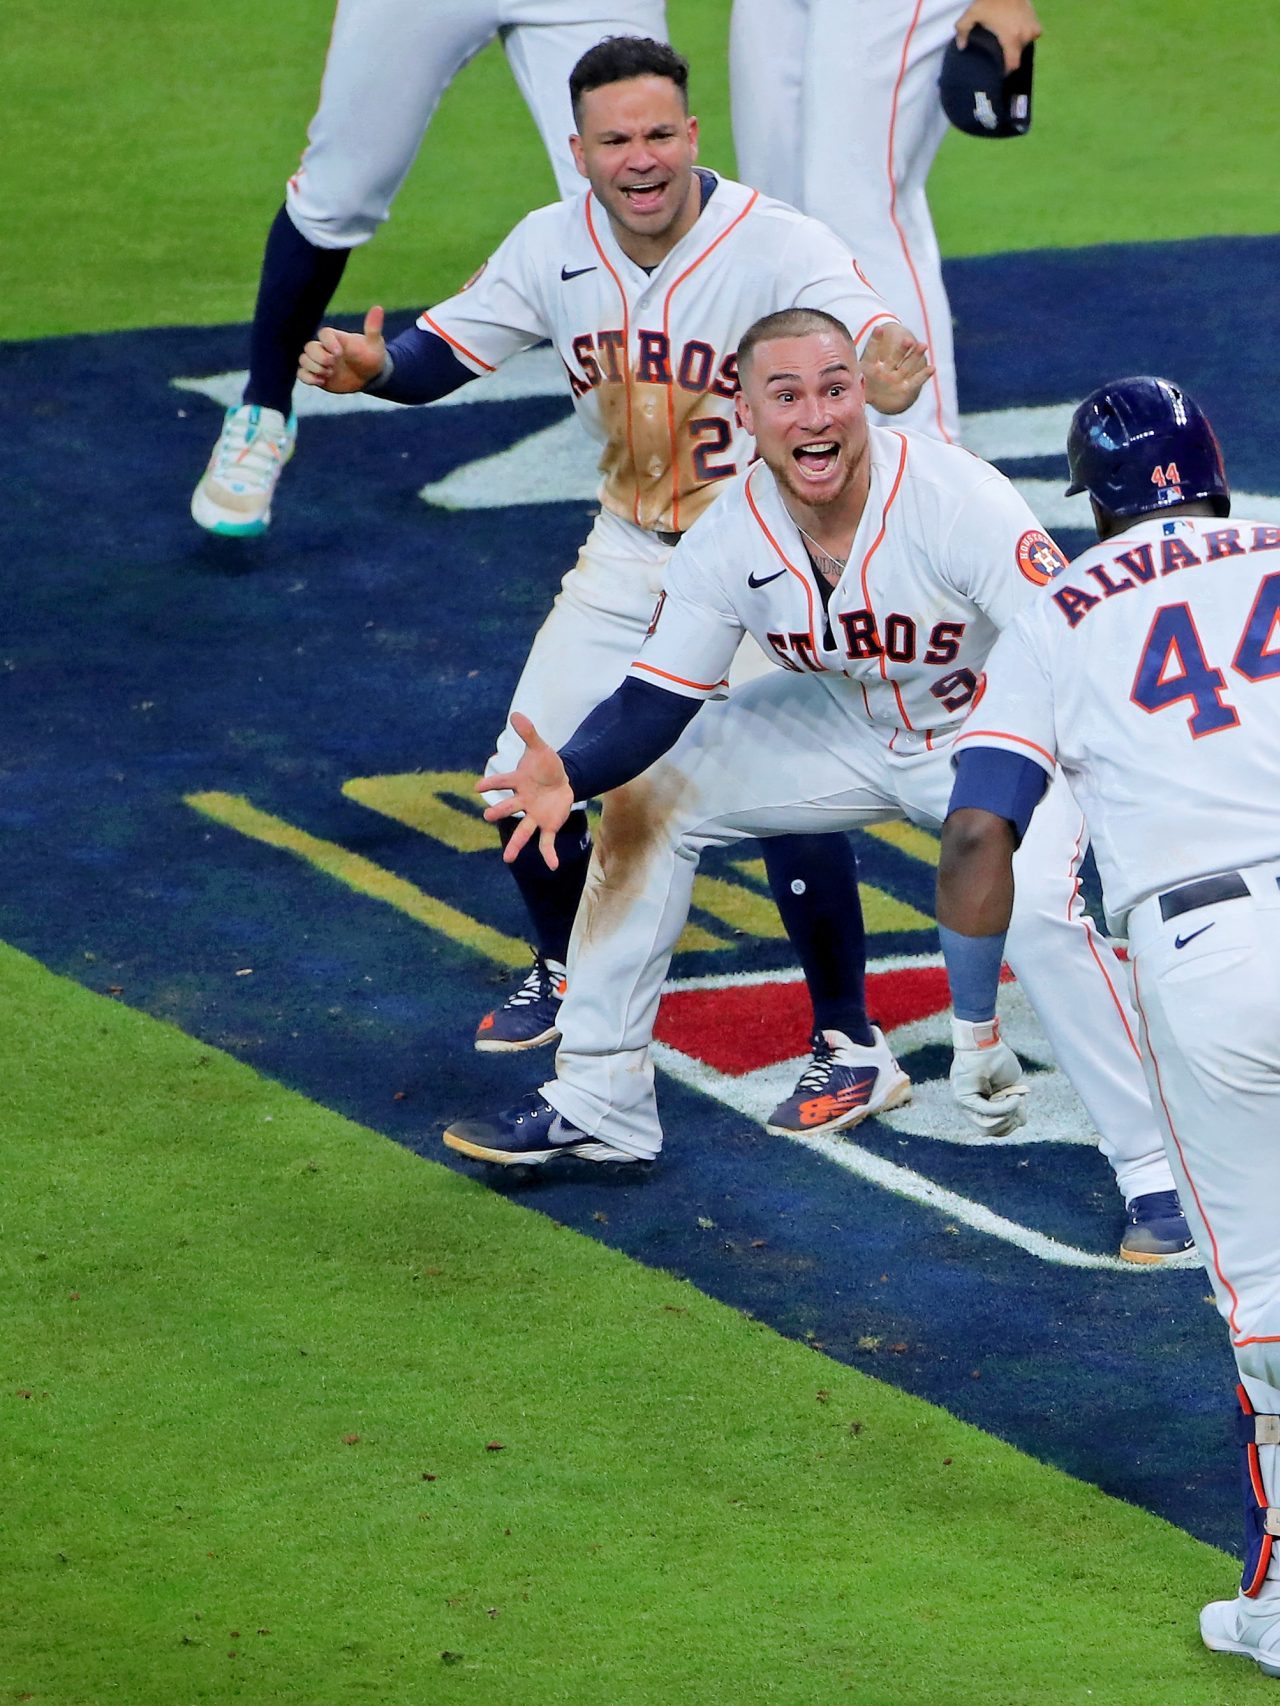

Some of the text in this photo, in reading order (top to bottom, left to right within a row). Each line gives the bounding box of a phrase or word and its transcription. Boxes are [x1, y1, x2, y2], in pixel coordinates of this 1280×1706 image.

[688, 411, 758, 482] 2
[1151, 462, 1181, 488] 44
[929, 667, 977, 713] 9
